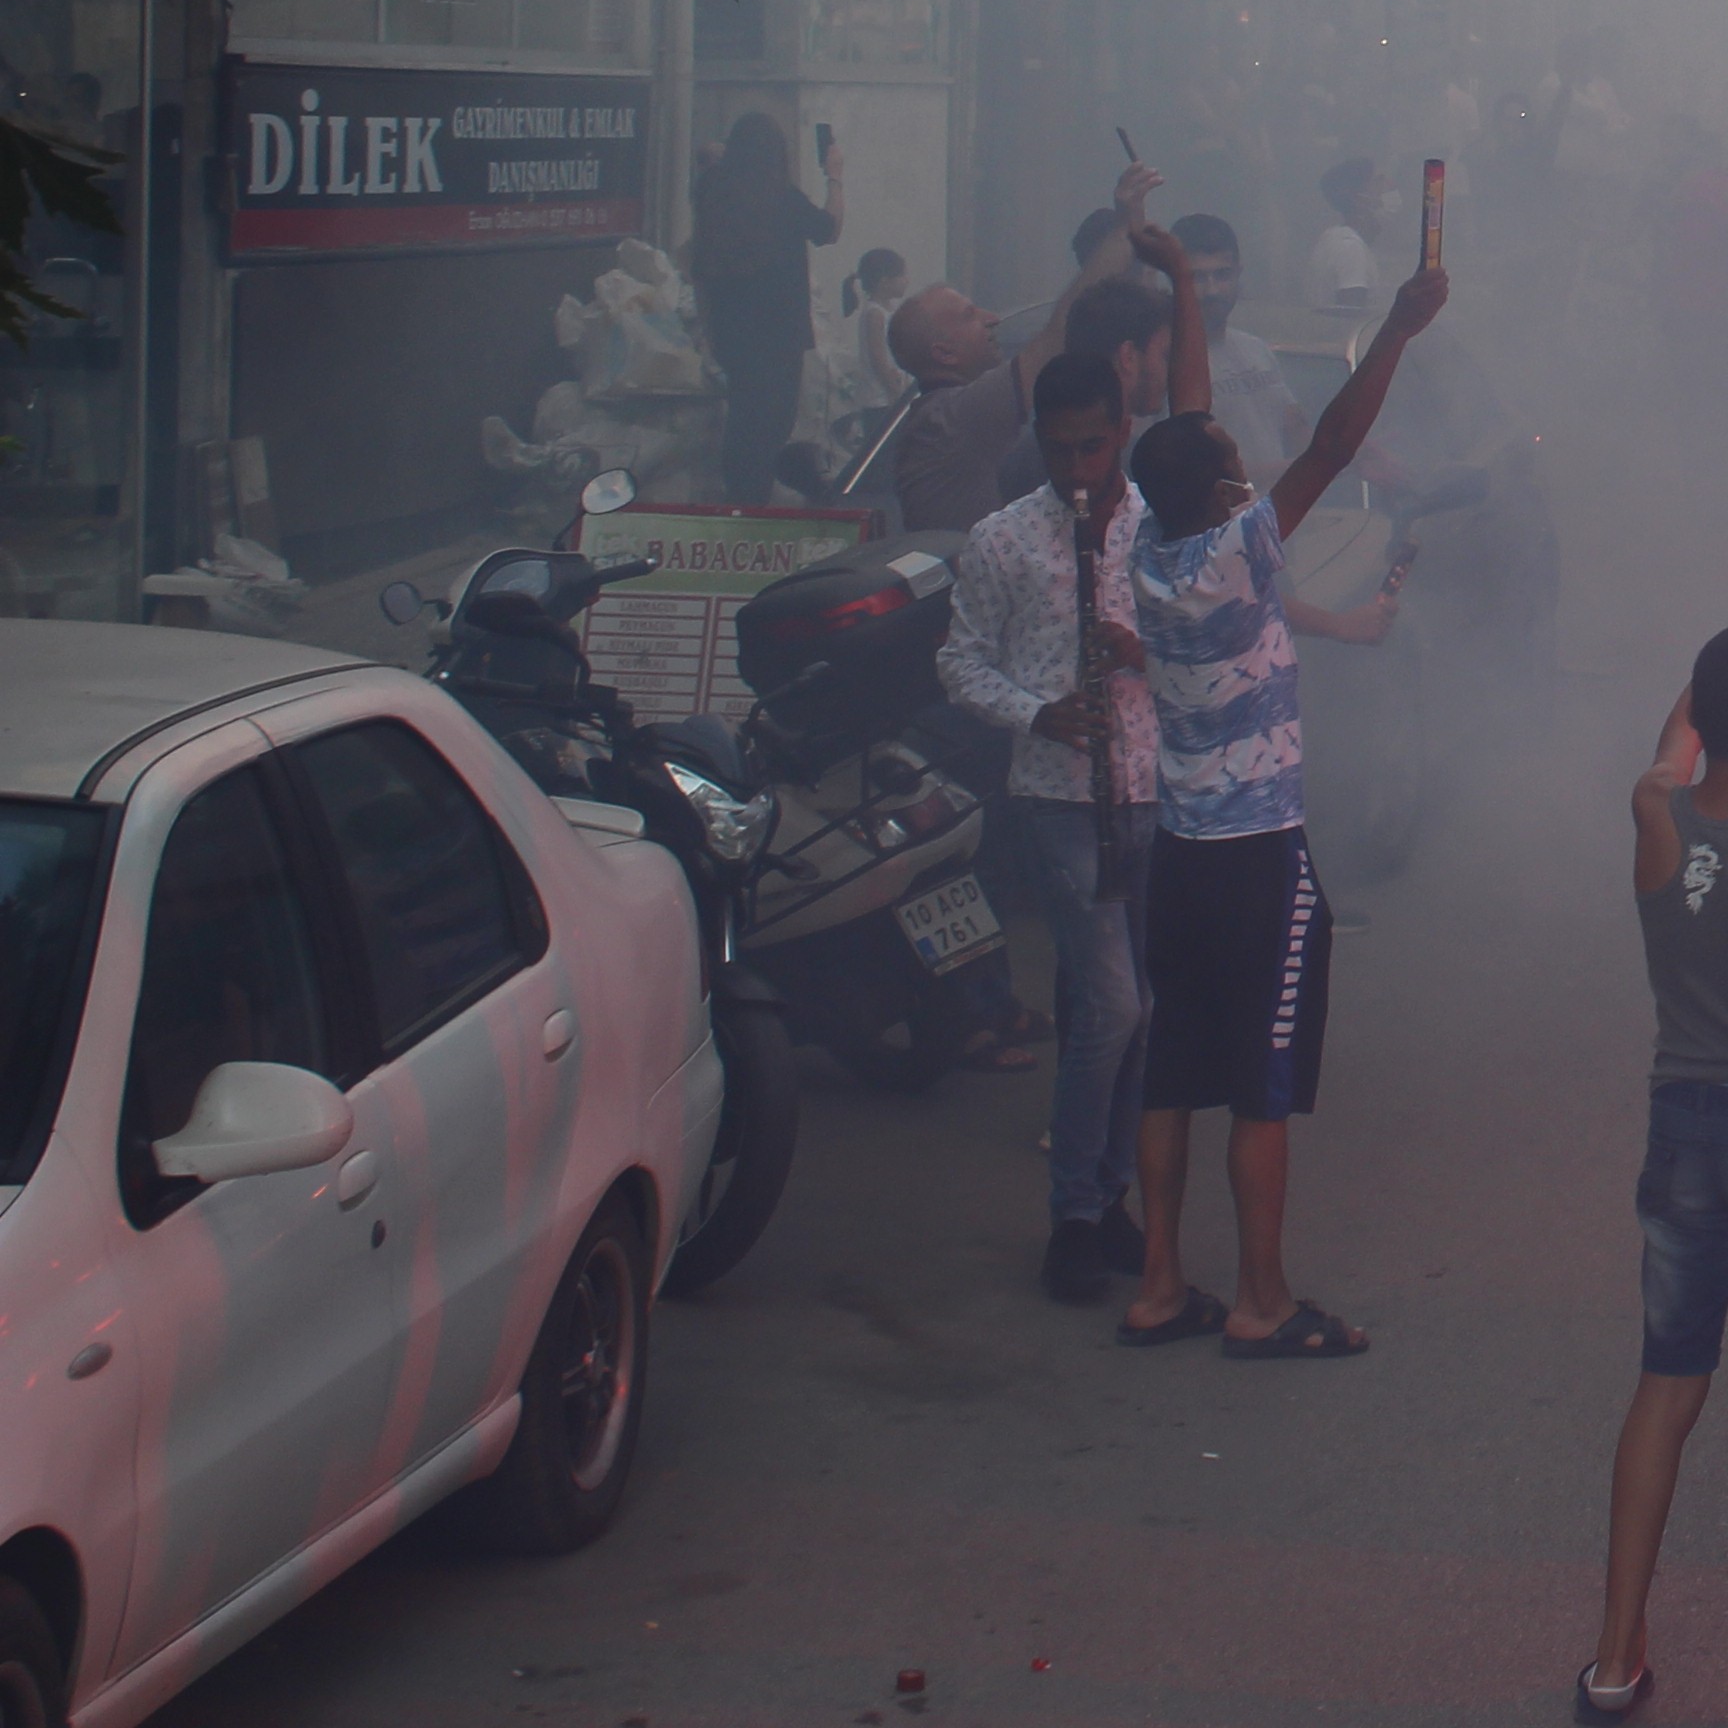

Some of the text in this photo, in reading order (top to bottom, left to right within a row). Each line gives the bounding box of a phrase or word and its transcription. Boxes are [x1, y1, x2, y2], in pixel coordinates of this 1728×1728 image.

[246, 88, 444, 197] DİLEK
[453, 99, 566, 140] GAYRİMENKUL
[584, 107, 636, 139] EMLAK
[646, 539, 795, 574] BABACAN
[905, 903, 932, 930] 10
[934, 915, 978, 951] 761
